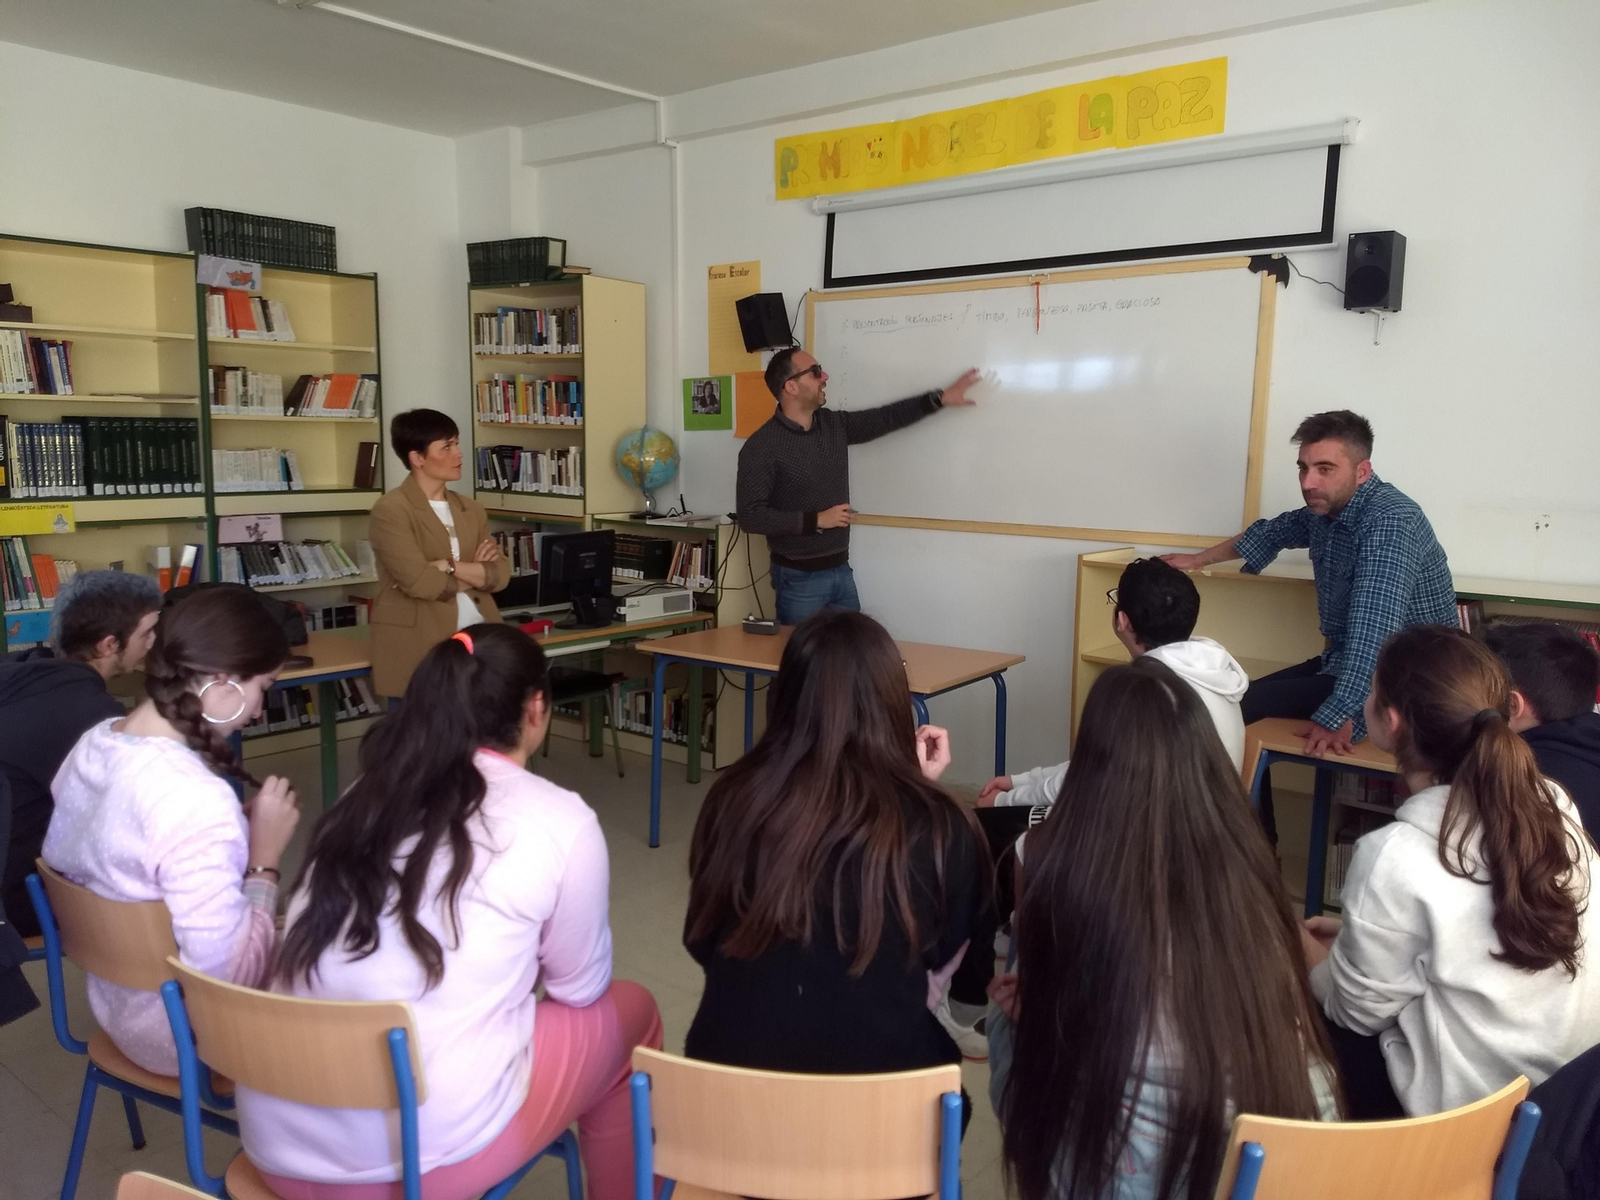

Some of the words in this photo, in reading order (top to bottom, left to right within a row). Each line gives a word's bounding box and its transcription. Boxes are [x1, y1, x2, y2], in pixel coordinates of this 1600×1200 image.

[901, 112, 1006, 172] NOBEL
[1014, 99, 1057, 154] DE
[1077, 92, 1114, 142] LA
[1125, 76, 1214, 141] PAZ
